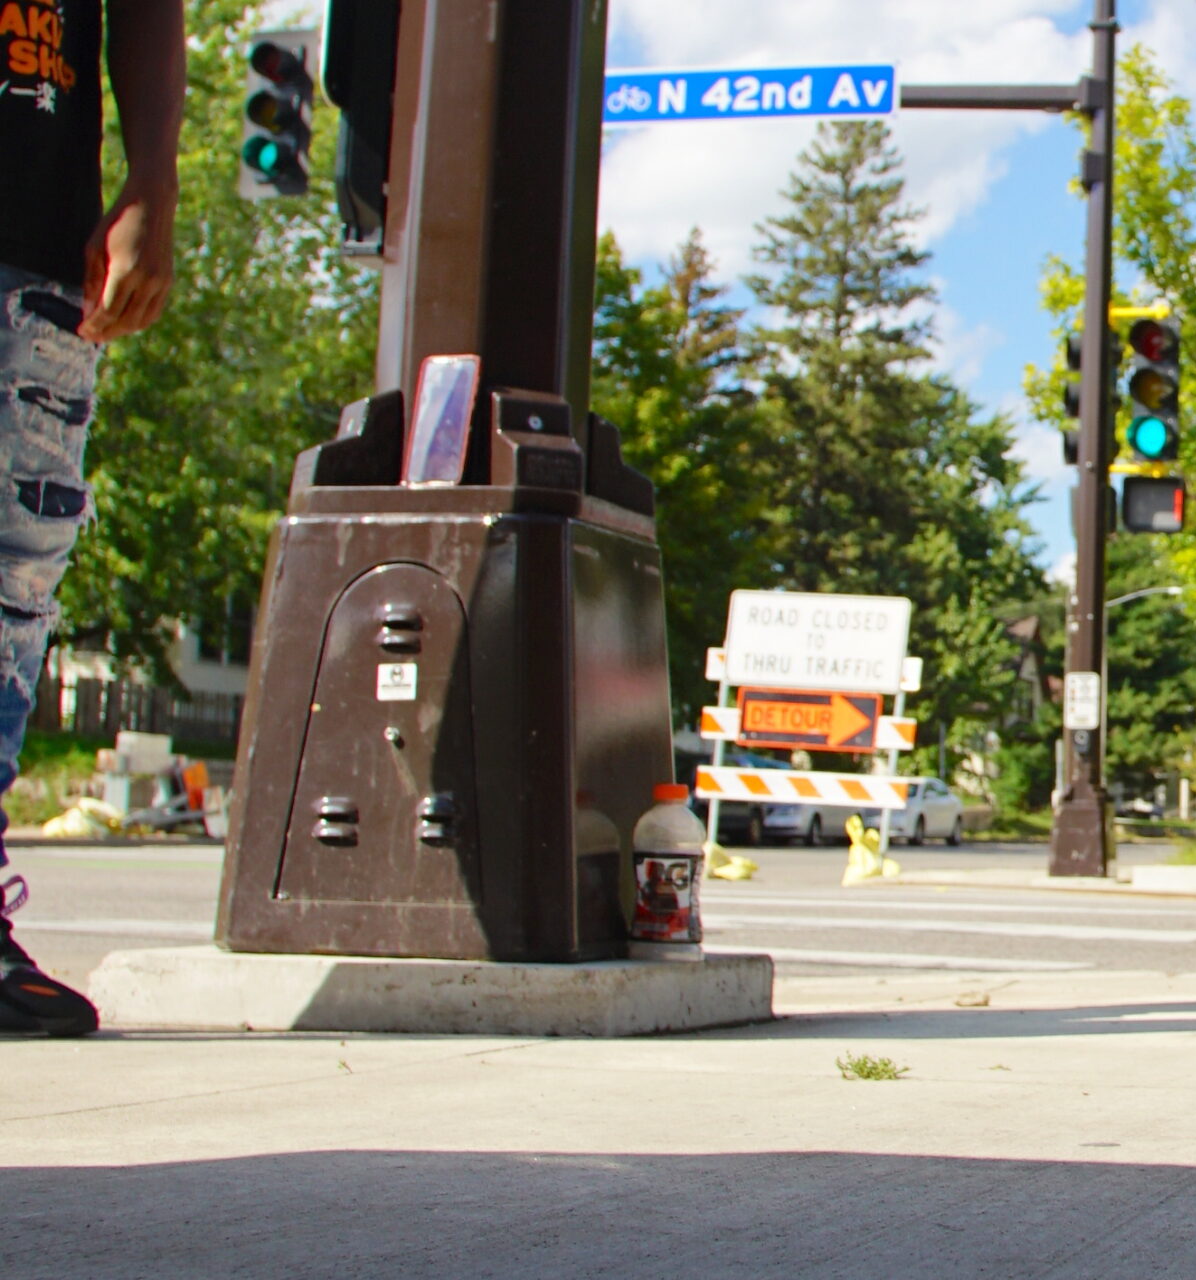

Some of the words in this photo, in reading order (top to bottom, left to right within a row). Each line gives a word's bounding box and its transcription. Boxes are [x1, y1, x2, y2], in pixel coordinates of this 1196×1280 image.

[658, 78, 687, 114] N
[701, 74, 813, 112] 42nd
[827, 72, 888, 108] Av
[746, 605, 799, 627] ROAD
[812, 609, 889, 631] CLOSED
[806, 632, 825, 649] TO
[743, 652, 791, 674] THRU
[805, 655, 885, 679] TRAFFIC
[750, 705, 833, 731] DETOUR
